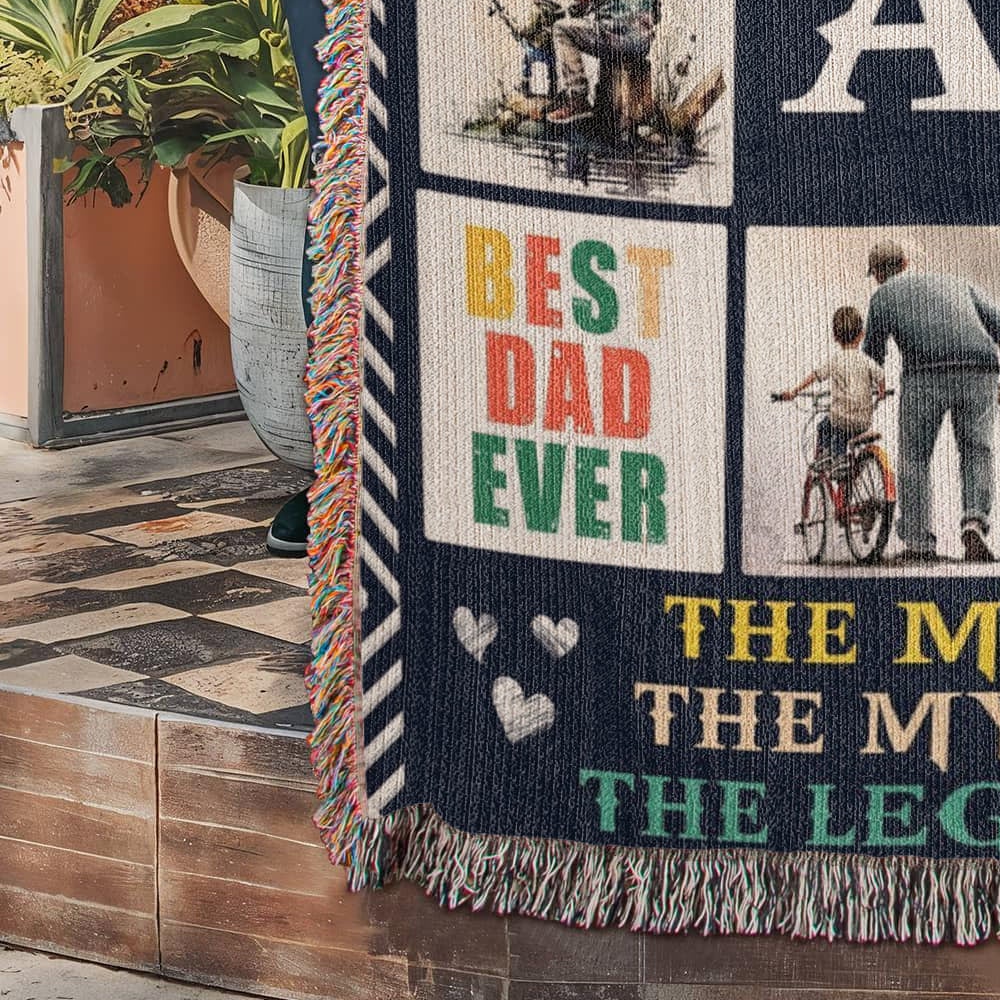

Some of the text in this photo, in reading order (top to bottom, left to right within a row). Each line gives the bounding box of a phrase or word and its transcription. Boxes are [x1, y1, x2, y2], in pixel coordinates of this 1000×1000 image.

[465, 224, 674, 339] BEST
[485, 331, 651, 439] DAD
[471, 431, 668, 545] EVER
[663, 595, 857, 664] THE
[634, 682, 824, 753] THE
[579, 769, 768, 844] THE
